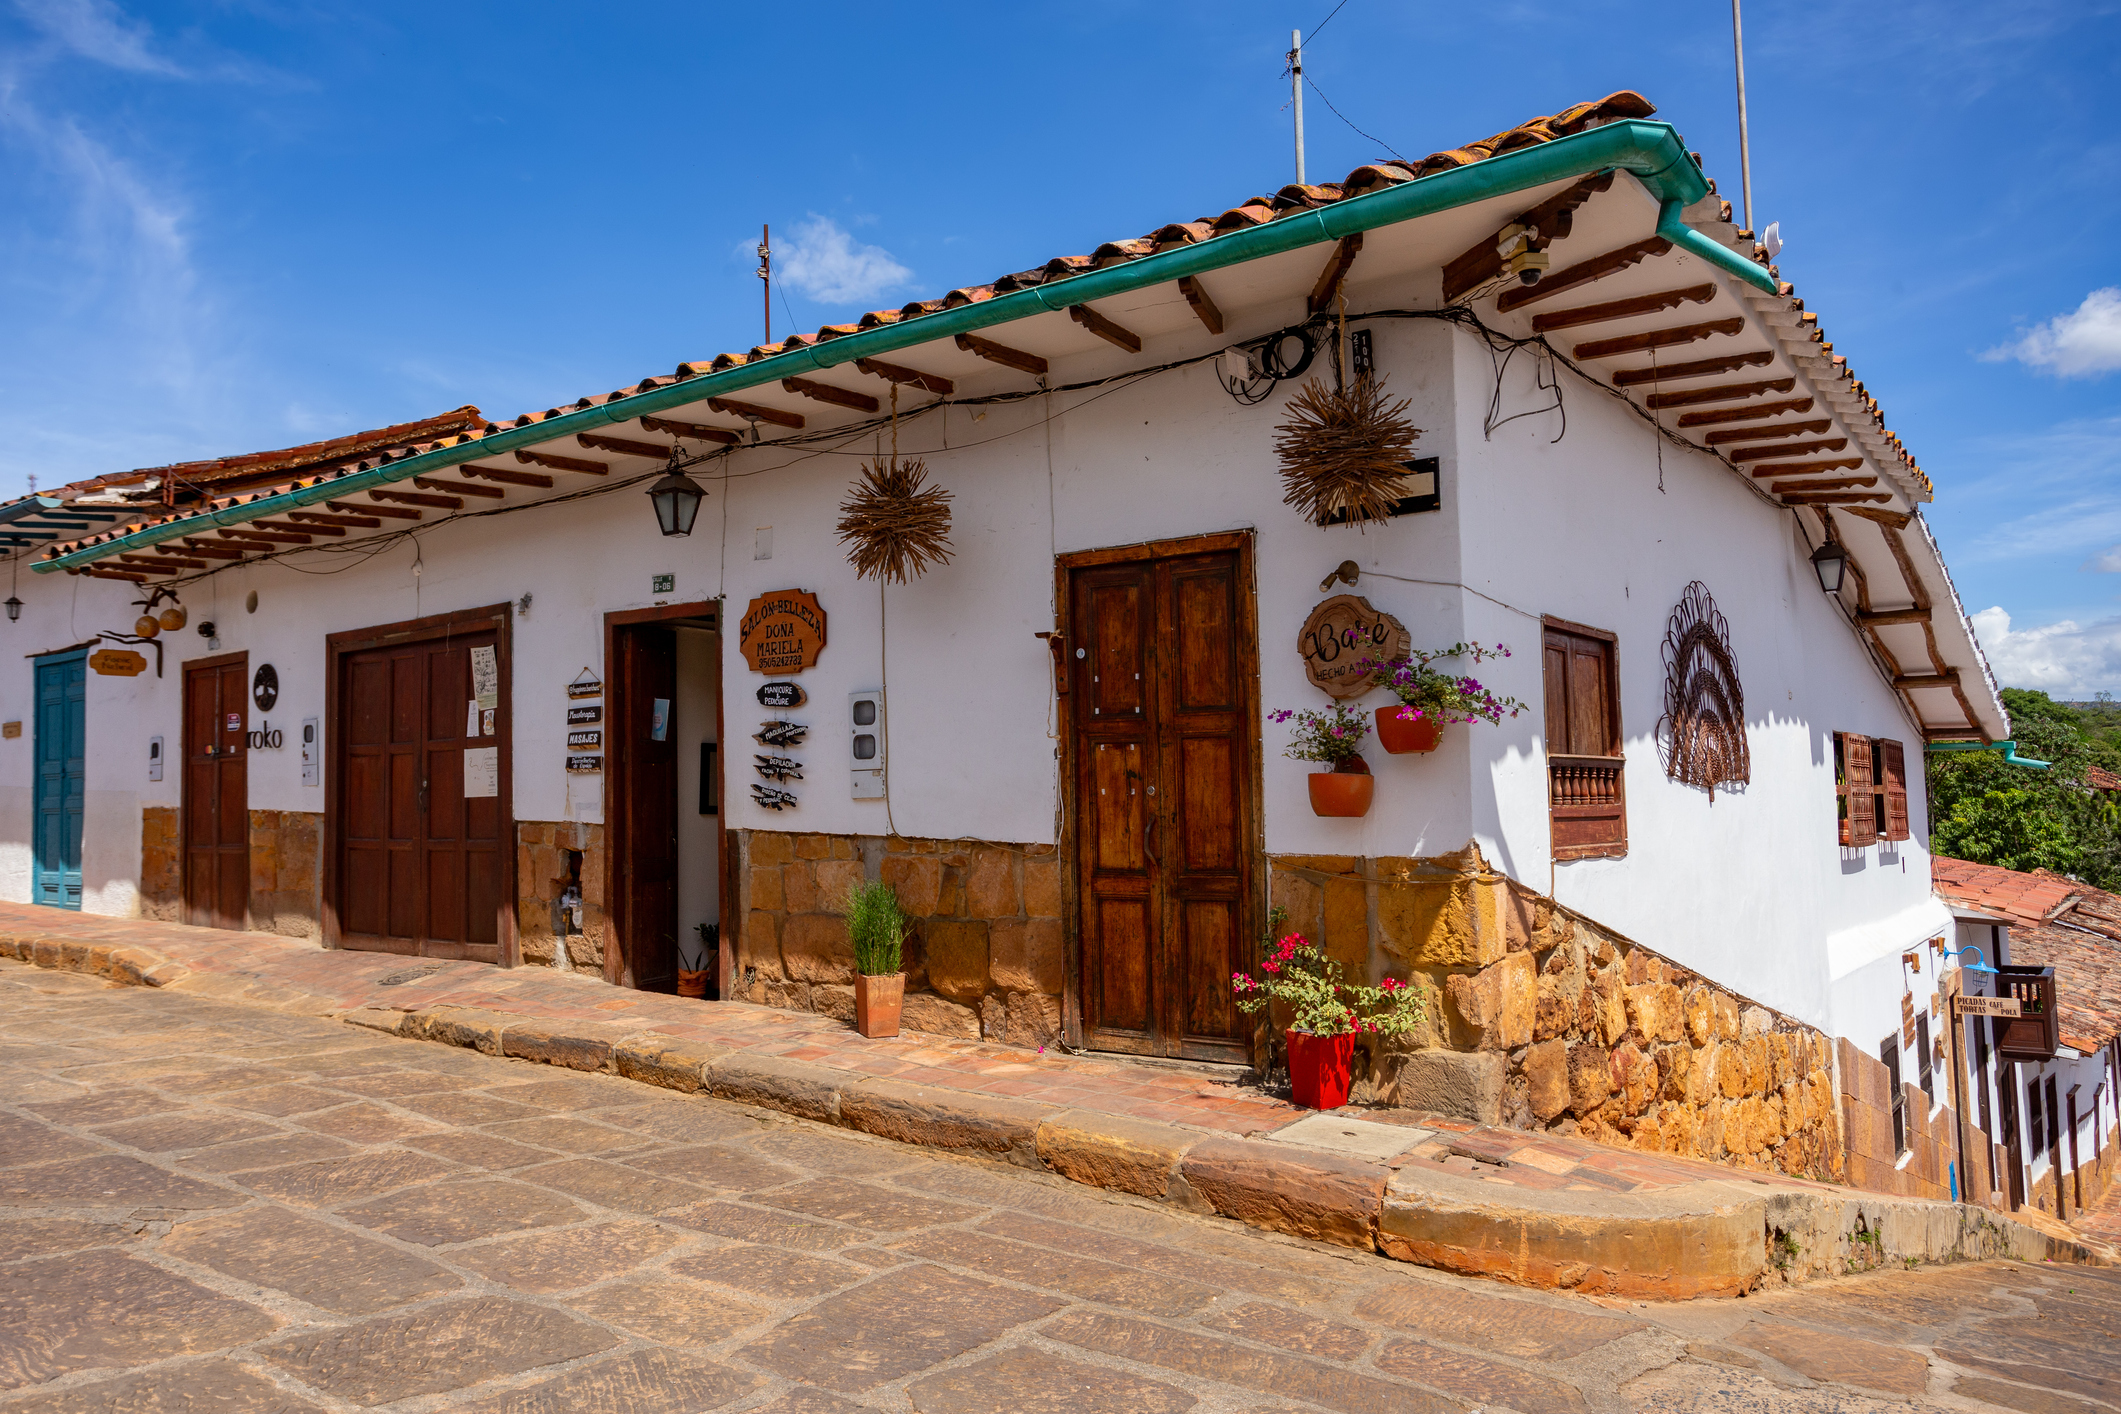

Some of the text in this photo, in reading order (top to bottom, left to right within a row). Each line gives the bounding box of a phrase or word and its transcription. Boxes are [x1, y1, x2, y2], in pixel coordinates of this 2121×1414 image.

[741, 600, 775, 648] SALÓN
[778, 600, 822, 643] BELLEZA
[765, 621, 795, 639] DOÑA
[757, 639, 804, 657] MARIELA
[1316, 665, 1346, 681] HECHO
[1348, 663, 1356, 674] A
[764, 686, 793, 694] MANICURE
[764, 697, 789, 706] PEDICURE
[765, 723, 795, 740] MAQUILLAJE
[569, 733, 598, 744] MASAJES
[1957, 997, 1987, 1006] PICADAS
[1989, 1000, 2004, 1009] CAFÉ
[1959, 1005, 1987, 1014] TORTAS
[2000, 1008, 2018, 1016] POLA
